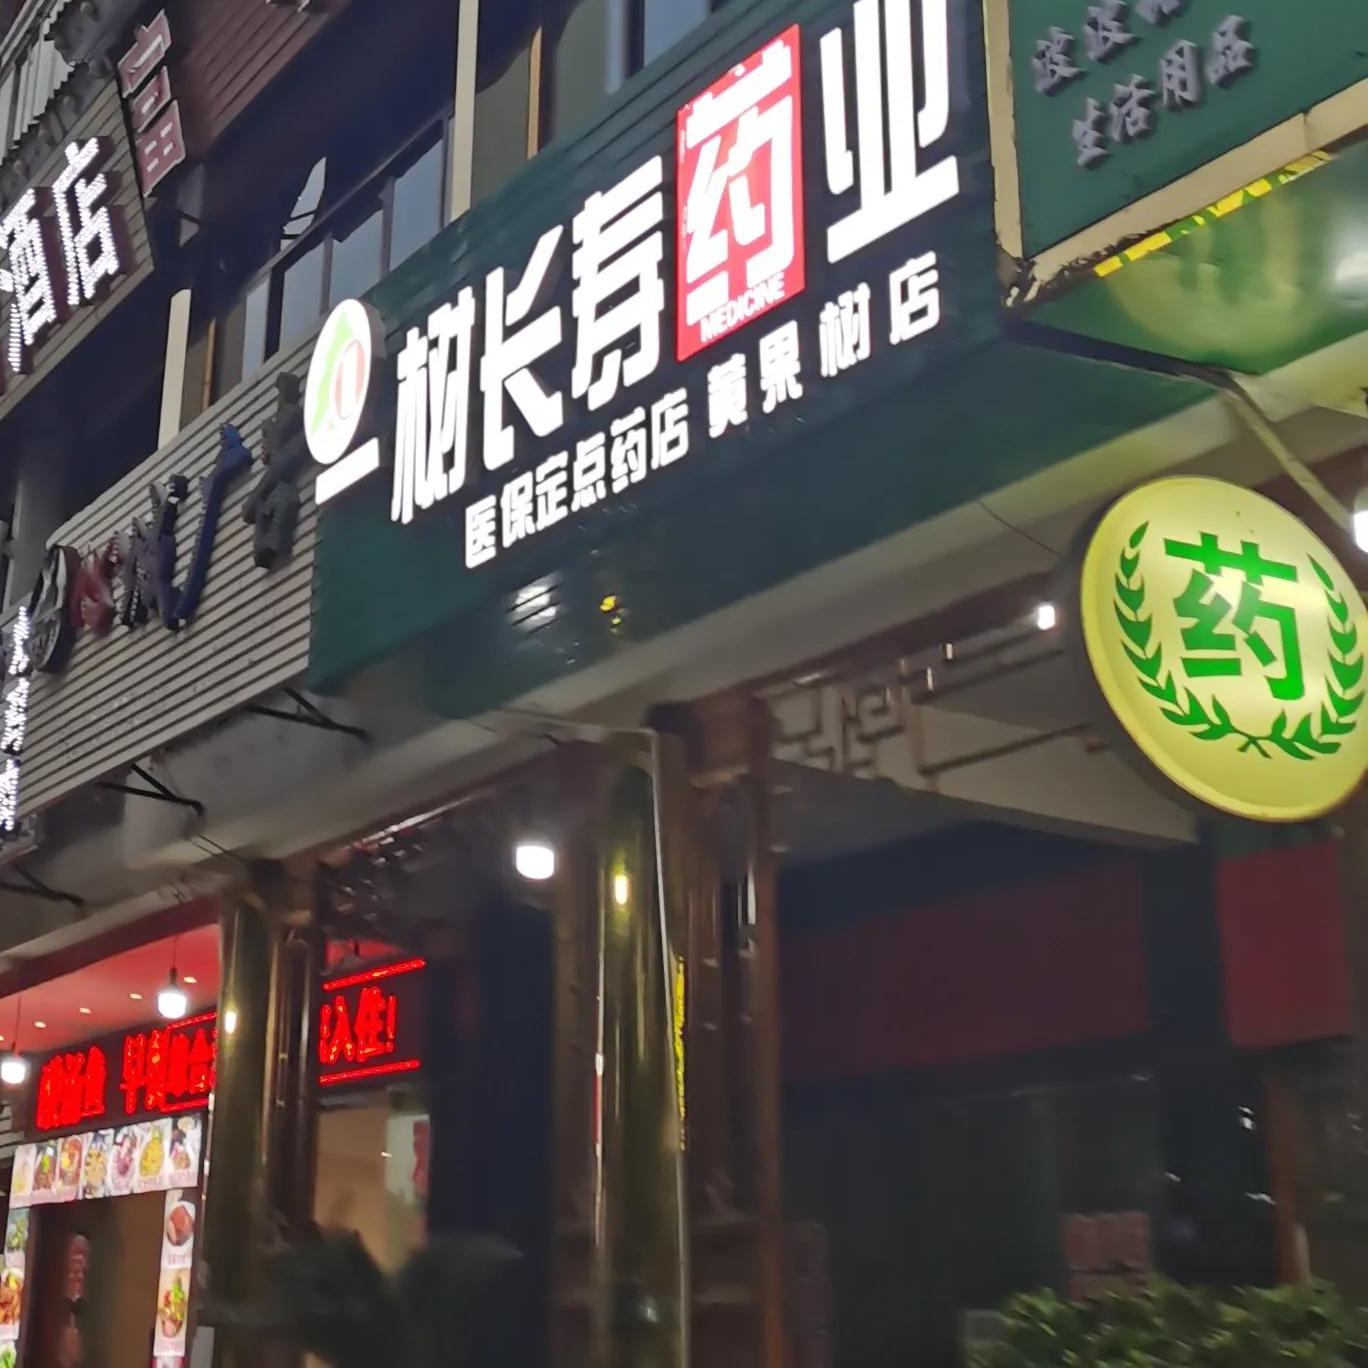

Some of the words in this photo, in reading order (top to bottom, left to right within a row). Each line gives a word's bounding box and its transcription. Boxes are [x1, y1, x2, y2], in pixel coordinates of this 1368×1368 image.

[700, 271, 785, 343] MEDICINE
[464, 386, 690, 569] 医保定点药店
[707, 252, 939, 438] 黄果树店
[1163, 531, 1305, 702] 药
